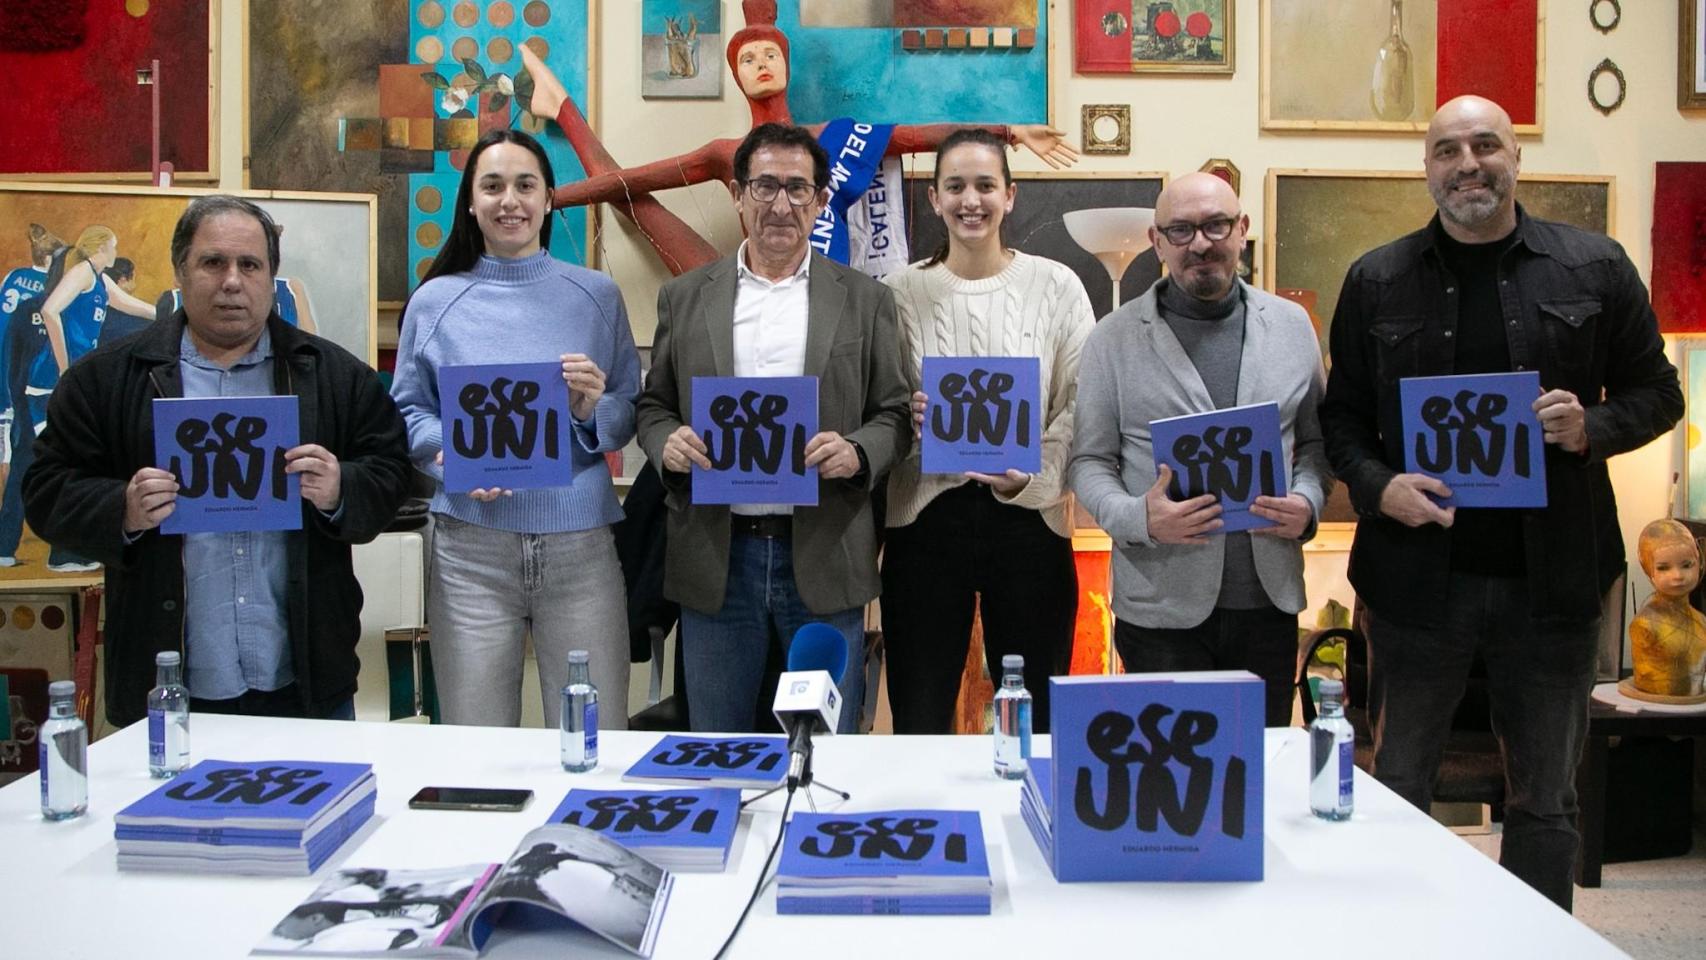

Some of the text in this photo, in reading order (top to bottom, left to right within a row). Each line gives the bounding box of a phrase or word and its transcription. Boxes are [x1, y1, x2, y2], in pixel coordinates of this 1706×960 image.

[839, 133, 868, 160] EL
[459, 377, 540, 417] ese
[939, 368, 1014, 404] ese
[710, 390, 788, 430] ese
[931, 399, 1030, 448] UNI
[1421, 390, 1508, 431] ese
[175, 412, 268, 454] ese
[453, 408, 559, 460] UNI
[704, 423, 806, 477] UNI
[1172, 426, 1253, 466] ese
[1415, 422, 1530, 479] UNI
[169, 446, 288, 501] UNI
[1167, 450, 1276, 503] UNI
[675, 741, 770, 753] ese
[1086, 703, 1218, 766] ese
[205, 766, 323, 784] ese
[652, 751, 783, 771] UNI
[165, 781, 333, 805] UNI
[585, 795, 699, 812] ese
[1074, 755, 1246, 840] UNI
[561, 809, 719, 834] UNI
[816, 817, 938, 837] ese
[800, 833, 968, 864] UNI
